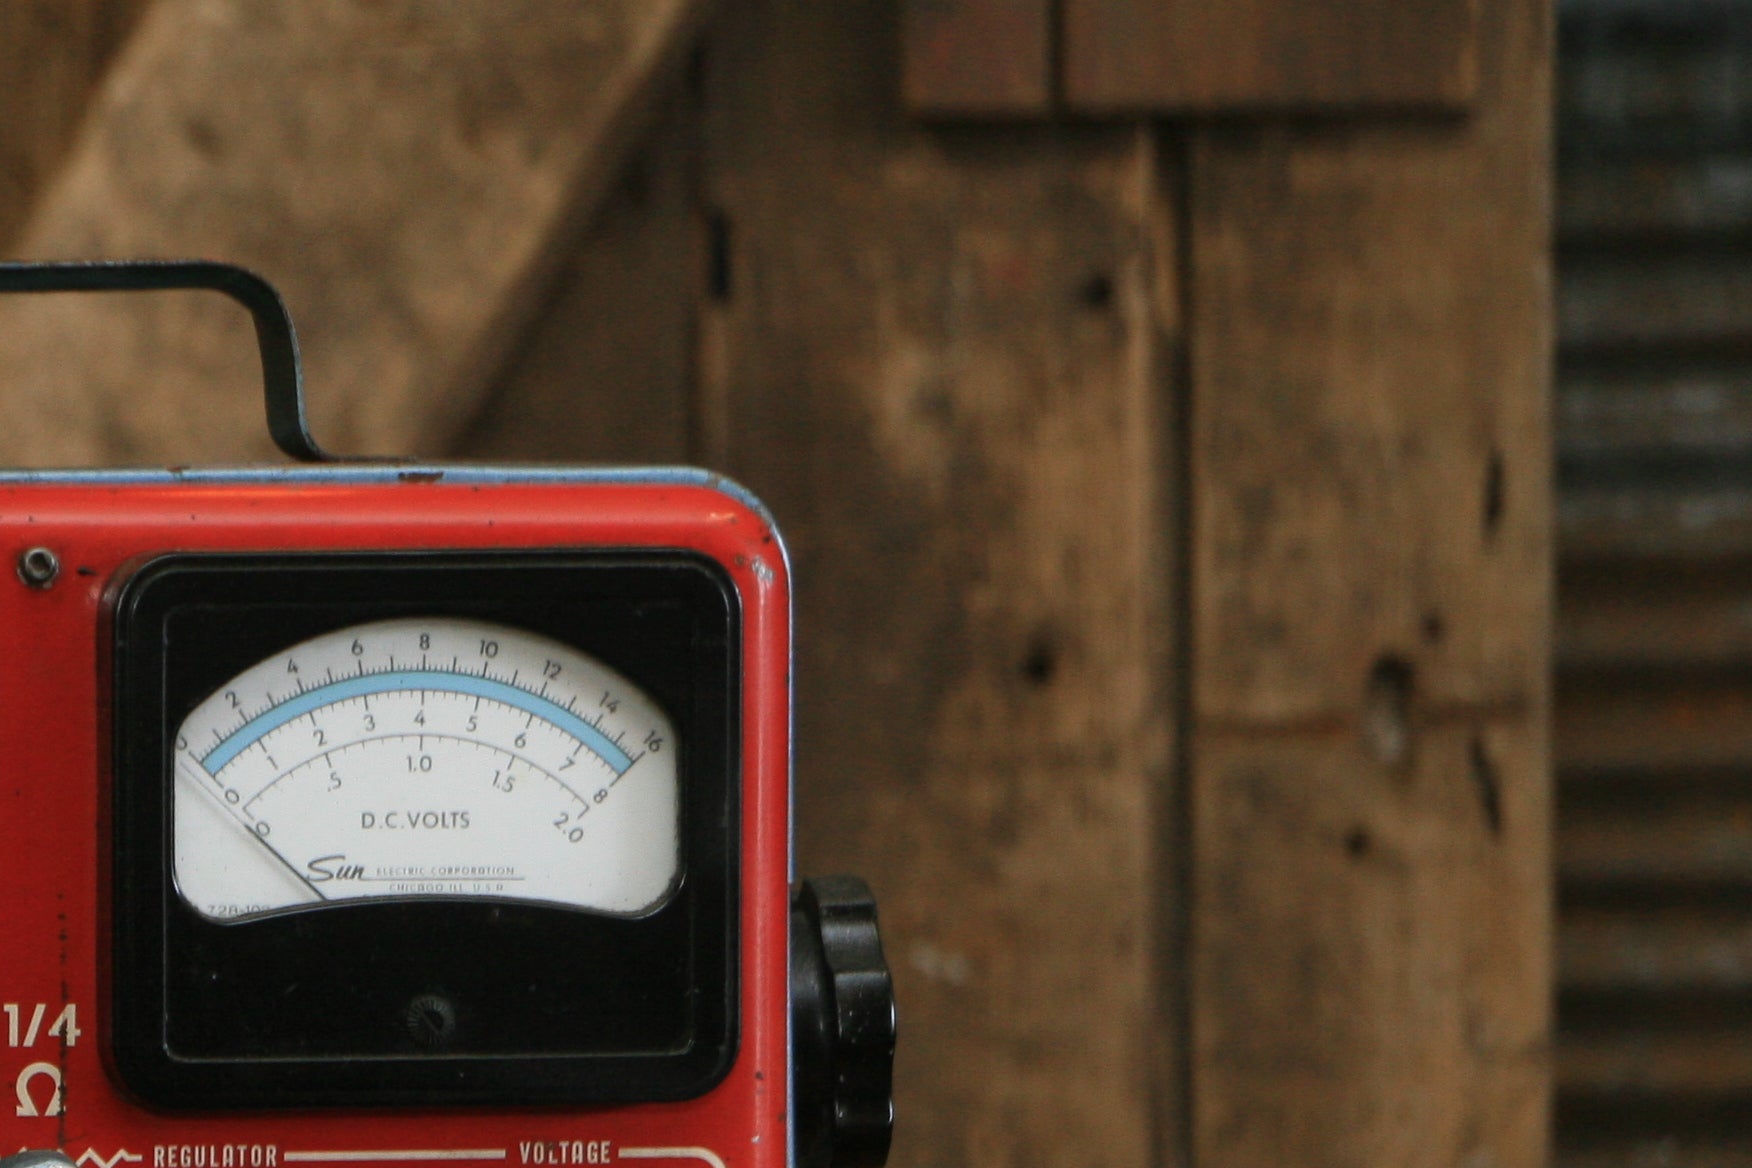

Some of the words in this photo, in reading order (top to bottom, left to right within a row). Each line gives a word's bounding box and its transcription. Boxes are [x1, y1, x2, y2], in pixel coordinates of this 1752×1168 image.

[225, 691, 240, 709] 2
[287, 658, 298, 674] 4
[351, 639, 363, 656] 6
[419, 634, 430, 651] 8
[479, 640, 498, 659] 10
[542, 659, 562, 679] 12
[599, 691, 621, 714] 14
[643, 729, 663, 753] 16
[224, 789, 240, 804] 0
[266, 756, 279, 770] 1
[313, 729, 327, 747] 2
[363, 715, 376, 731] 3
[414, 710, 425, 726] 4
[466, 715, 478, 732] 5
[515, 732, 527, 749] 6
[558, 756, 575, 772] 7
[593, 788, 608, 804] 8
[255, 821, 271, 837] 0
[407, 755, 432, 772] 1.0
[492, 770, 516, 793] 1.5
[552, 812, 584, 844] 2.0
[306, 855, 365, 881] Sun
[376, 867, 425, 877] ELECTRIC
[431, 866, 515, 877] CORPORATION
[3, 1003, 81, 1047] 1/4
[153, 1144, 278, 1168] REGULATOR
[519, 1140, 611, 1164] VOLTAGE
